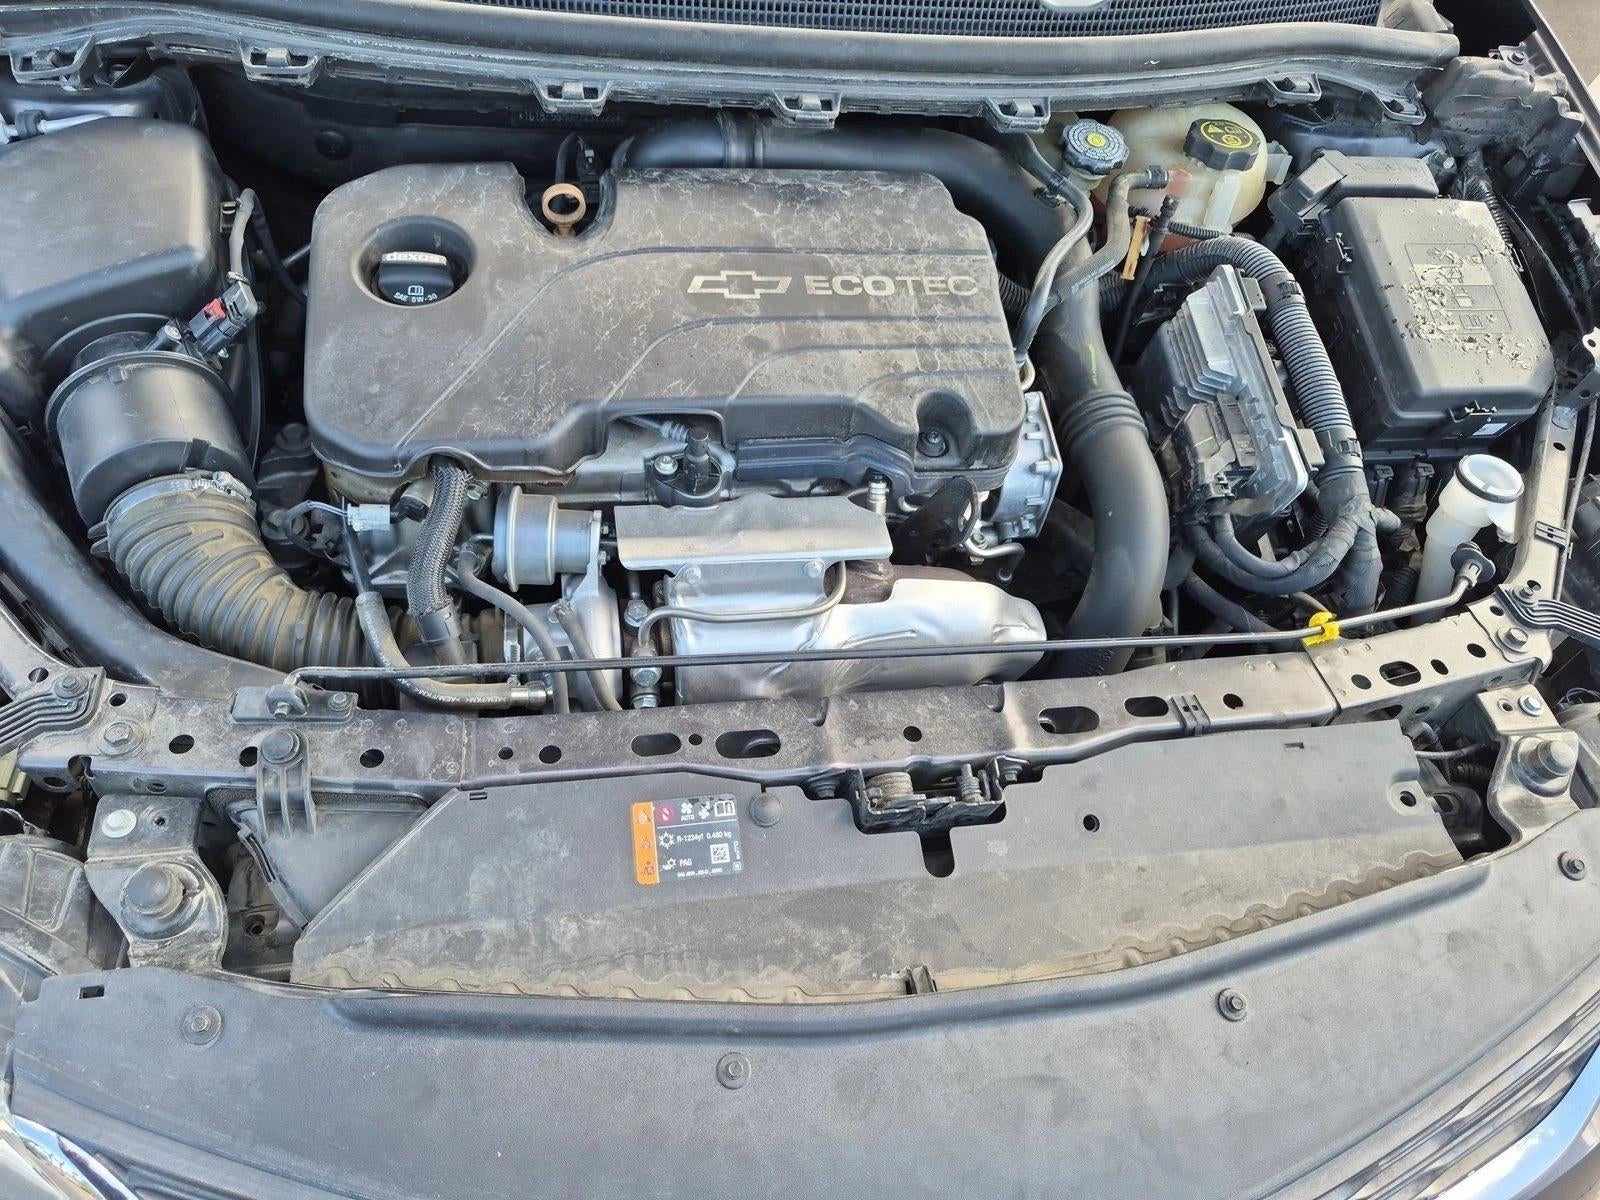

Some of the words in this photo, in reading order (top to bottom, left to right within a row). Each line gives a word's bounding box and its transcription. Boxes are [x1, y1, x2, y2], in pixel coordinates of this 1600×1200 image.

[804, 275, 979, 296] ECOTEC
[393, 291, 409, 302] SAE
[411, 293, 438, 303] 5W-30
[723, 830, 732, 839] kg
[679, 858, 692, 867] PAG
